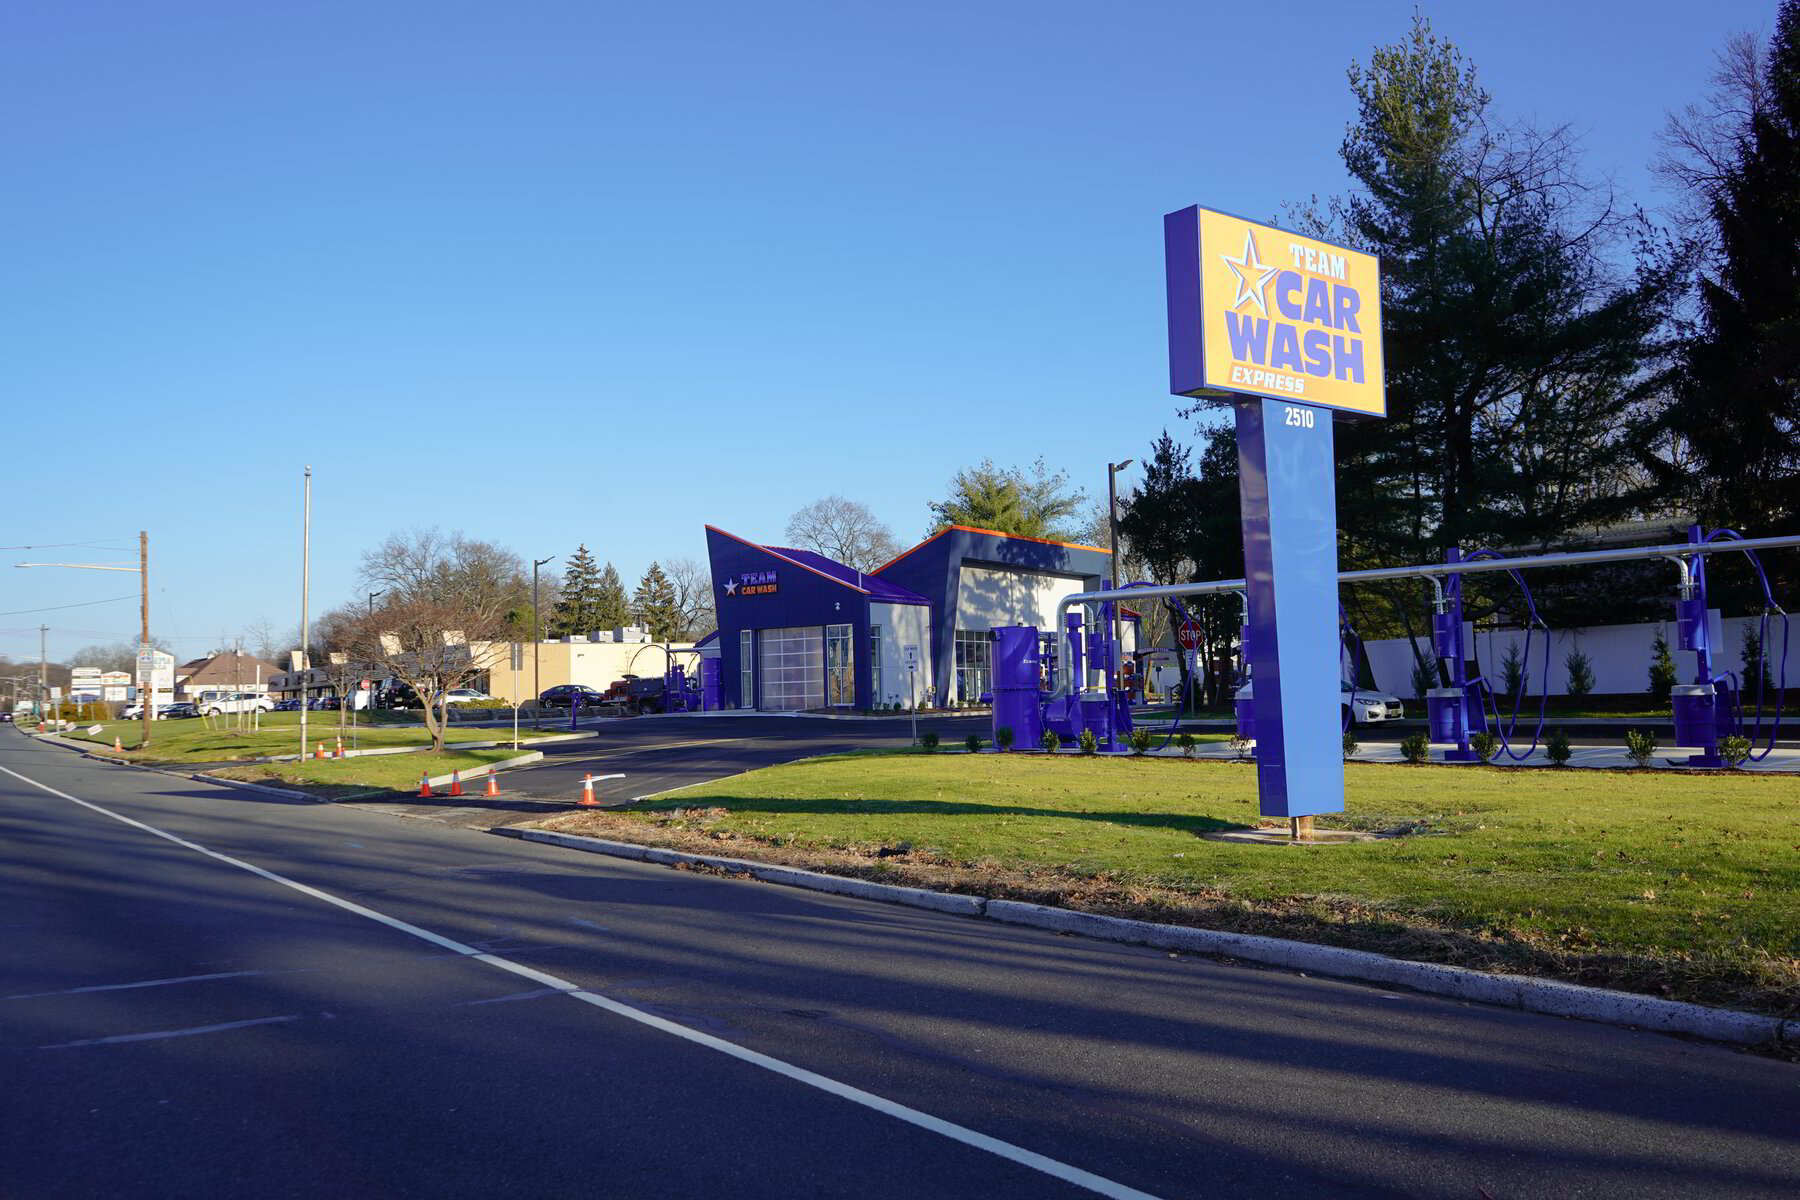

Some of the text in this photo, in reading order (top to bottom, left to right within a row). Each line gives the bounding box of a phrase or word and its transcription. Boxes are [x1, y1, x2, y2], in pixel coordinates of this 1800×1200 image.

[1288, 243, 1346, 280] TEAM
[1276, 270, 1361, 334] CAR
[1224, 309, 1365, 384] WASH
[1231, 367, 1305, 394] EXPRESS
[1285, 406, 1314, 428] 2510
[741, 571, 777, 585] TEAM
[741, 584, 777, 595] CAR WASH
[1180, 629, 1201, 641] STOP
